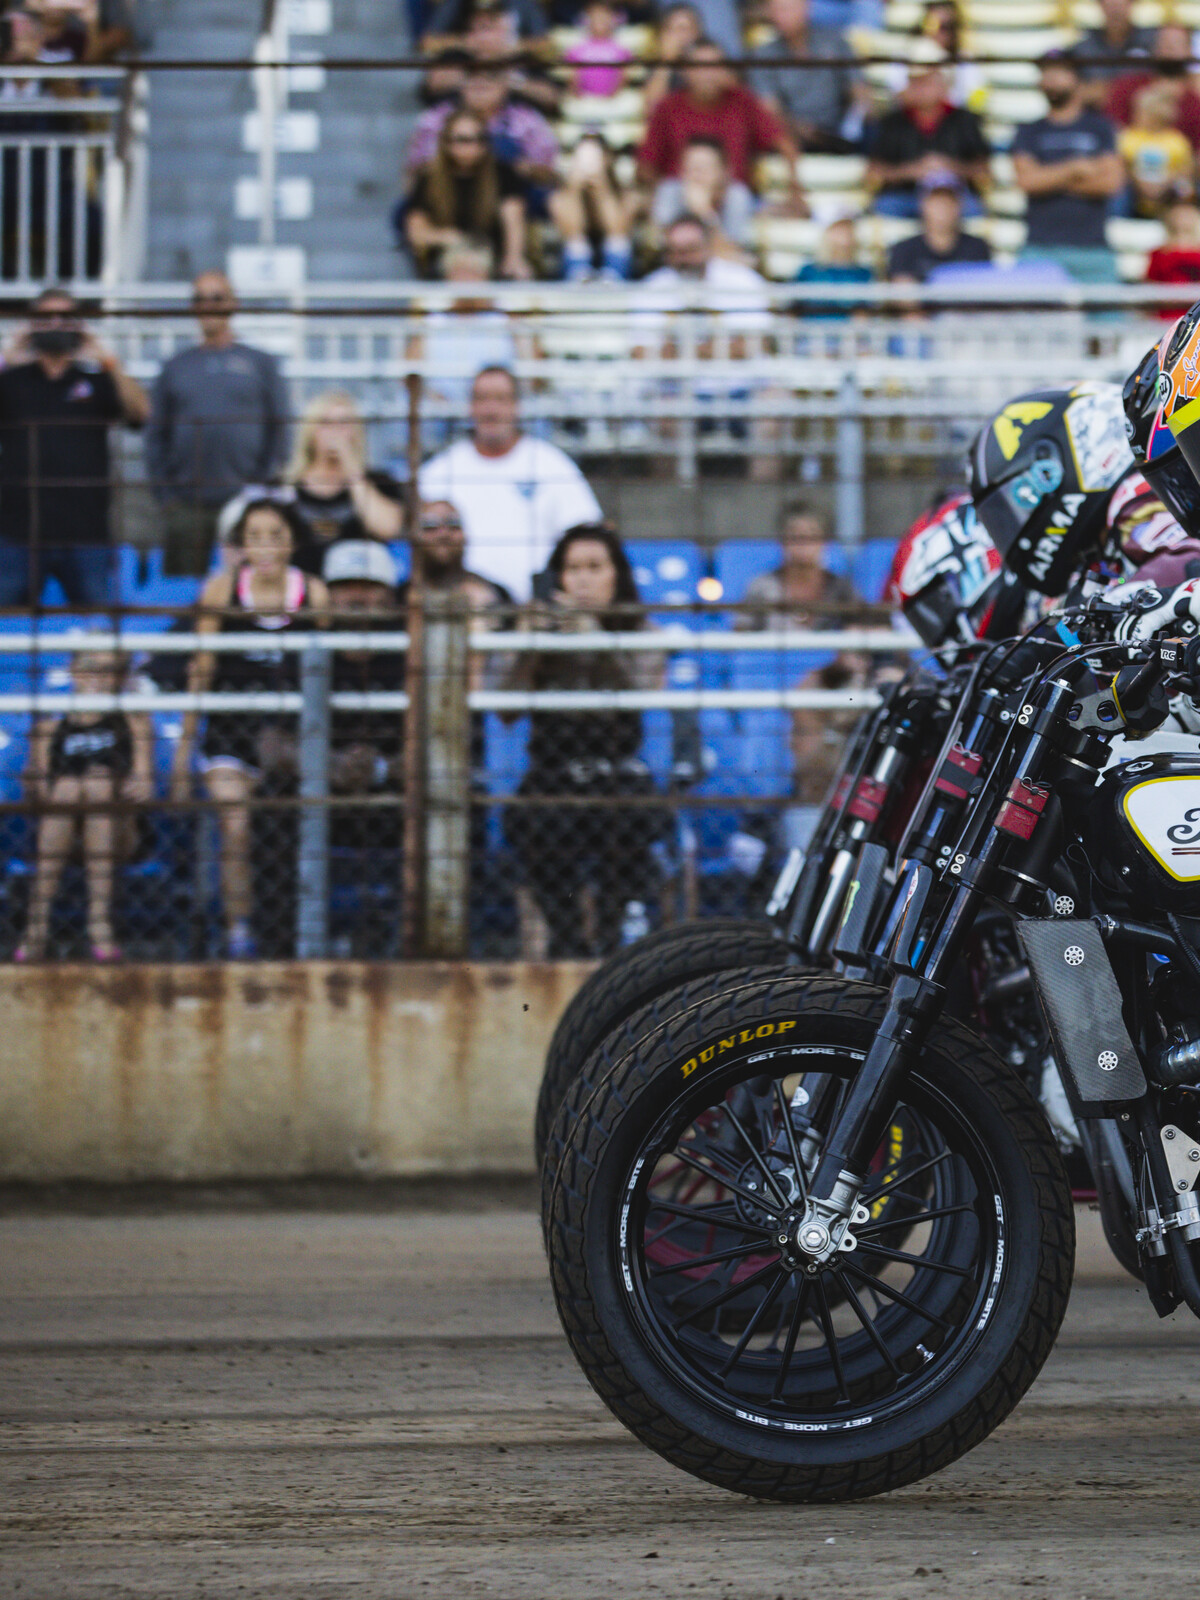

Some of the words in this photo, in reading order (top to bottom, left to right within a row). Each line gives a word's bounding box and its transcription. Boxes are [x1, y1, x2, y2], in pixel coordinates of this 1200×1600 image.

[680, 1020, 797, 1079] DUNLOP
[747, 1051, 777, 1064] GET
[791, 1047, 836, 1056] MORE
[850, 1051, 865, 1061] BI
[627, 1158, 645, 1190] BITE
[994, 1194, 1004, 1224] GET
[620, 1203, 630, 1248] MORE
[622, 1261, 633, 1292] GET
[992, 1239, 1005, 1283] MORE
[976, 1297, 994, 1330] BITE
[735, 1408, 769, 1427] BITE
[783, 1422, 828, 1432] MORE
[842, 1416, 873, 1429] GET
